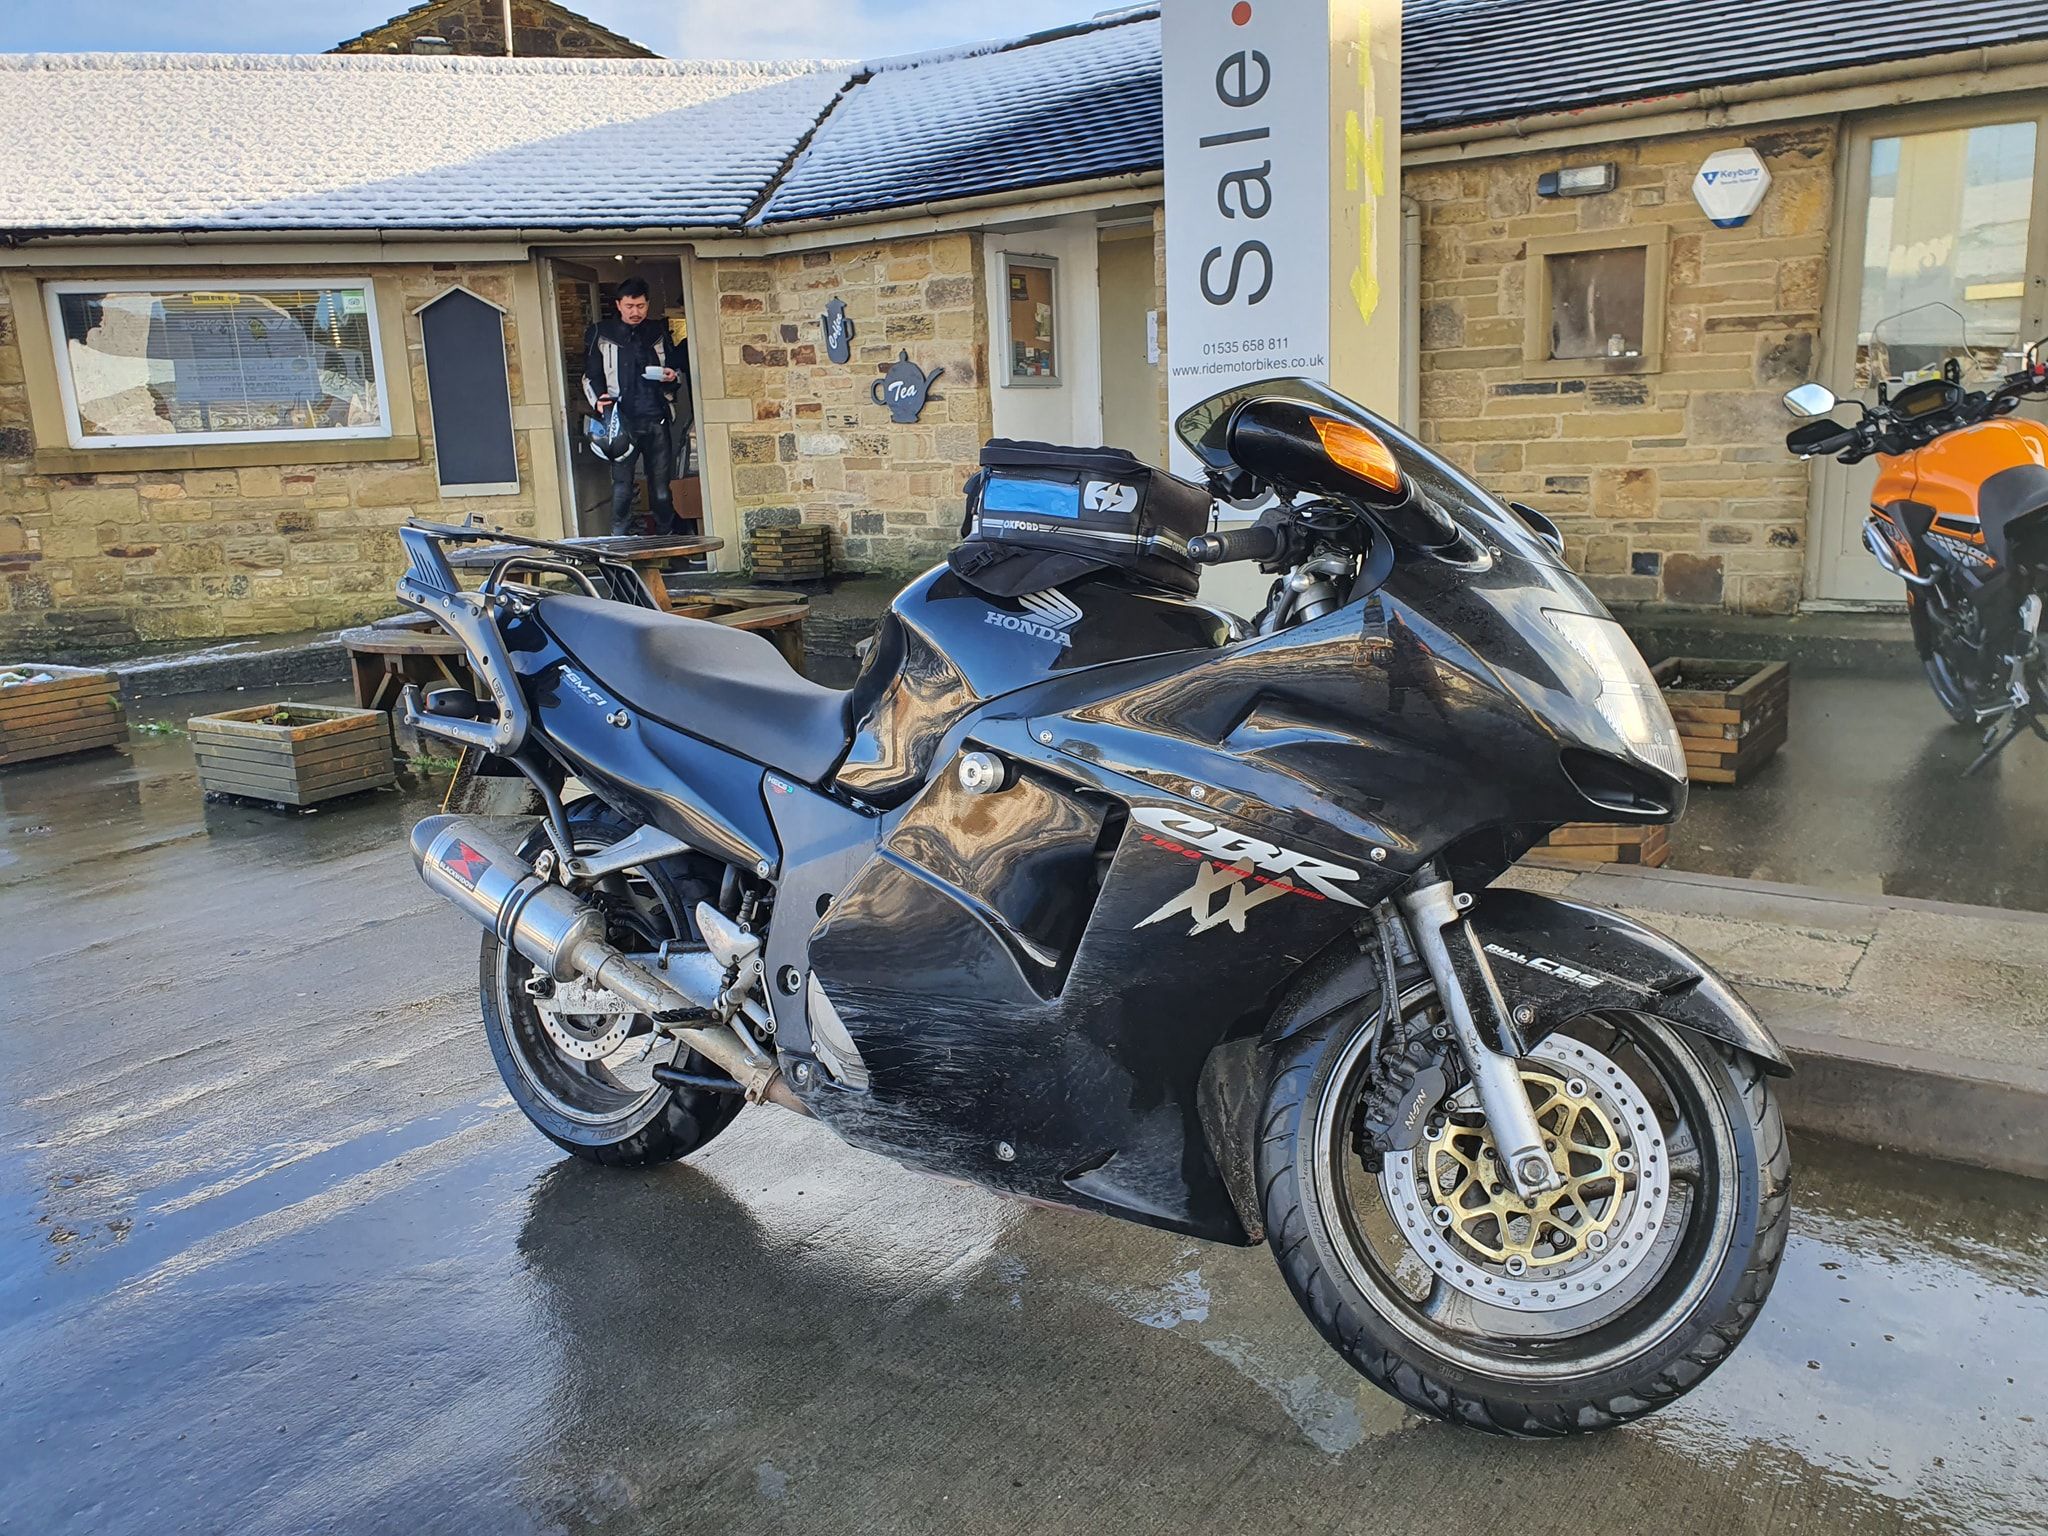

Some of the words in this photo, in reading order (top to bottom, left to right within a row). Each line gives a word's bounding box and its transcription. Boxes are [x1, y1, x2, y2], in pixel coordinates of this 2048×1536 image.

[1200, 49, 1273, 306] Sale
[1720, 168, 1760, 178] Keybury
[828, 313, 843, 349] Coffee
[1203, 341, 1238, 355] 01535
[1242, 339, 1264, 352] 658
[1268, 337, 1288, 350] 811
[1172, 354, 1324, 376] www.ridemotorbikes.co.uk
[888, 381, 917, 402] Tea
[1003, 519, 1039, 532] OXFORD
[984, 611, 1073, 648] HONDA
[1130, 807, 1370, 909] CBR
[1484, 943, 1528, 962] DUAL
[1527, 957, 1605, 986] CBS
[1405, 1088, 1427, 1130] NISSIN
